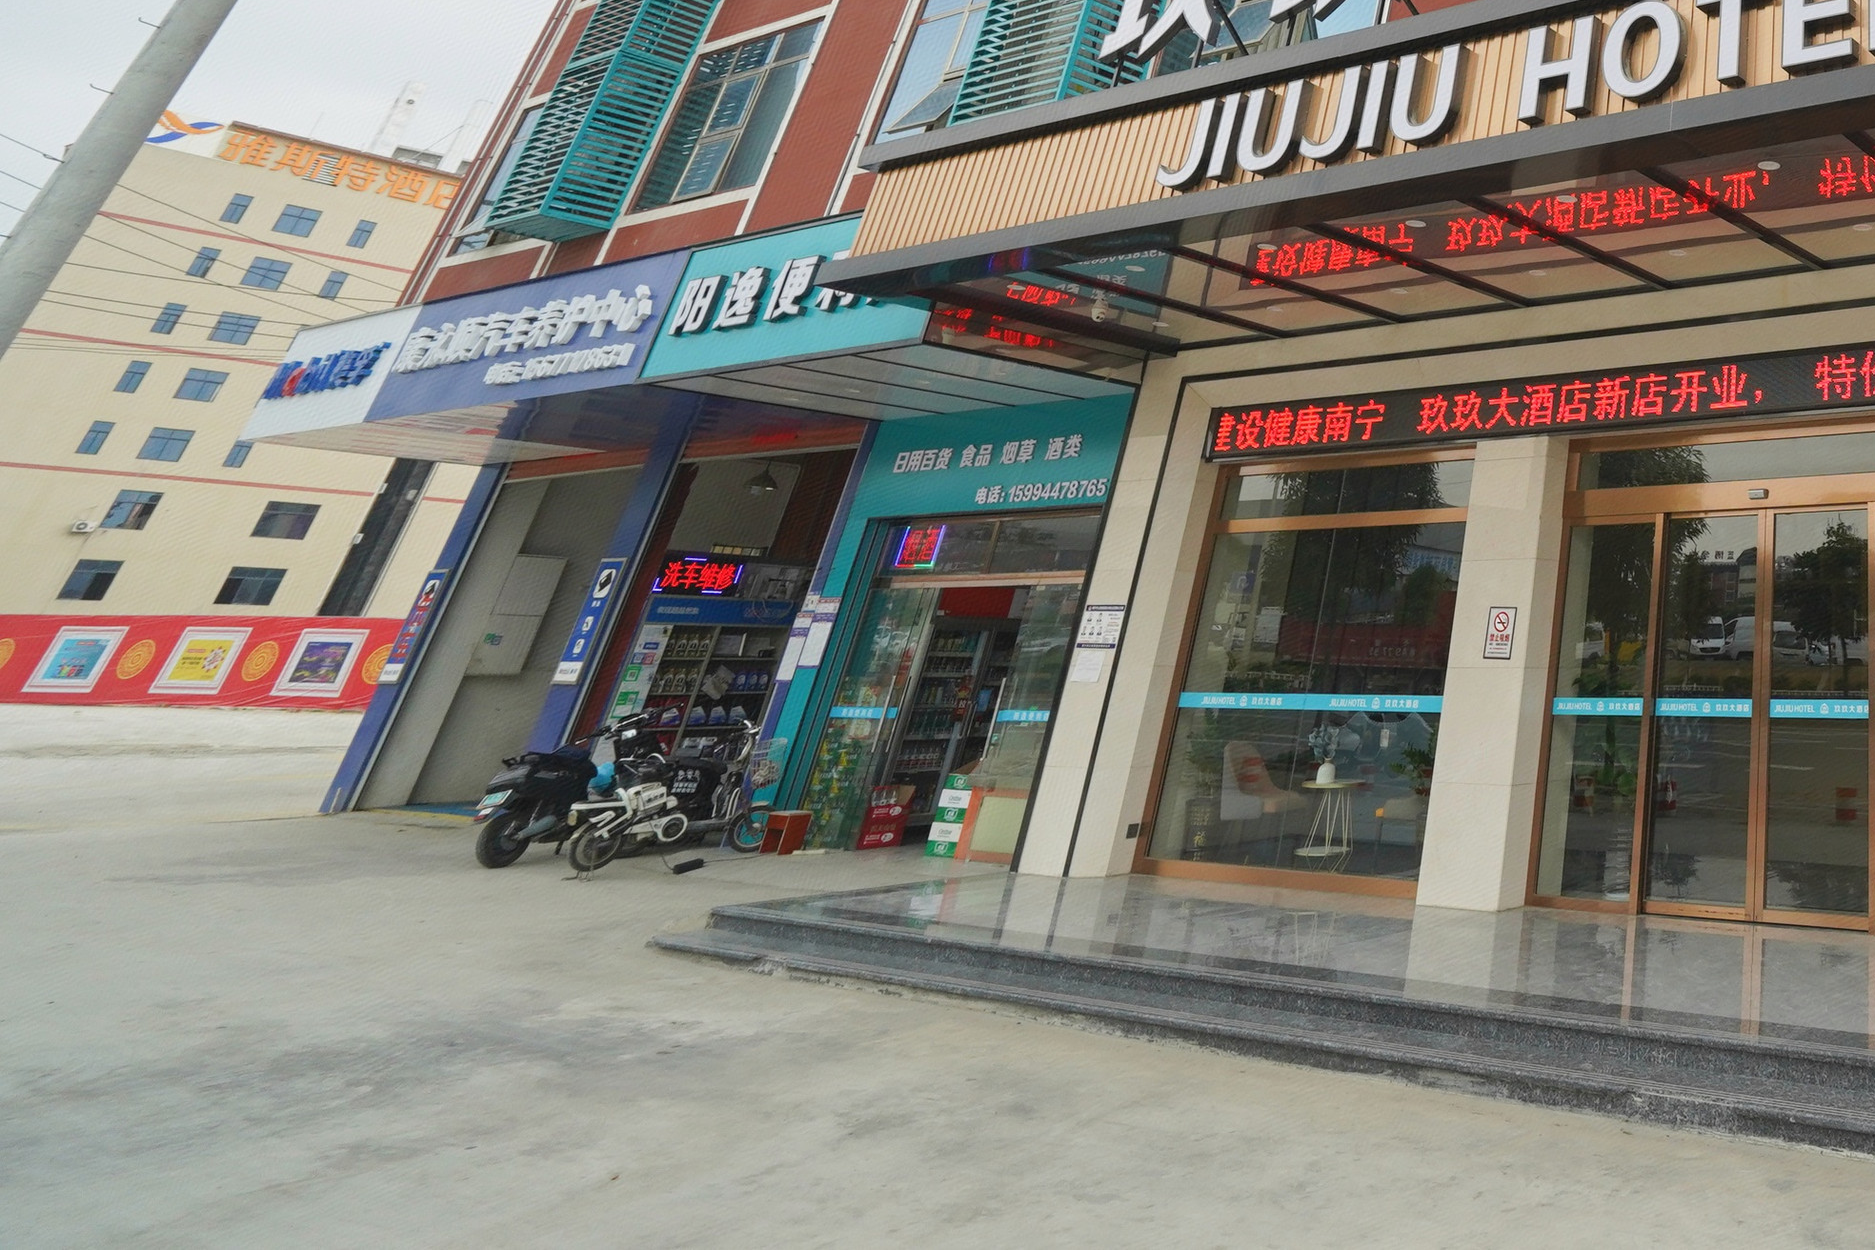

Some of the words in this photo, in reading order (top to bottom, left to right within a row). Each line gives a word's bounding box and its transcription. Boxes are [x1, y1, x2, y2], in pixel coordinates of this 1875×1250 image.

[1155, 43, 1466, 189] JIUJIU
[668, 249, 880, 338] 阳逸便
[893, 448, 952, 473] 日用百货
[960, 444, 993, 468] 食品
[1000, 439, 1036, 464] 烟草
[1045, 434, 1082, 461] 酒类
[660, 562, 735, 590] 洗车维修
